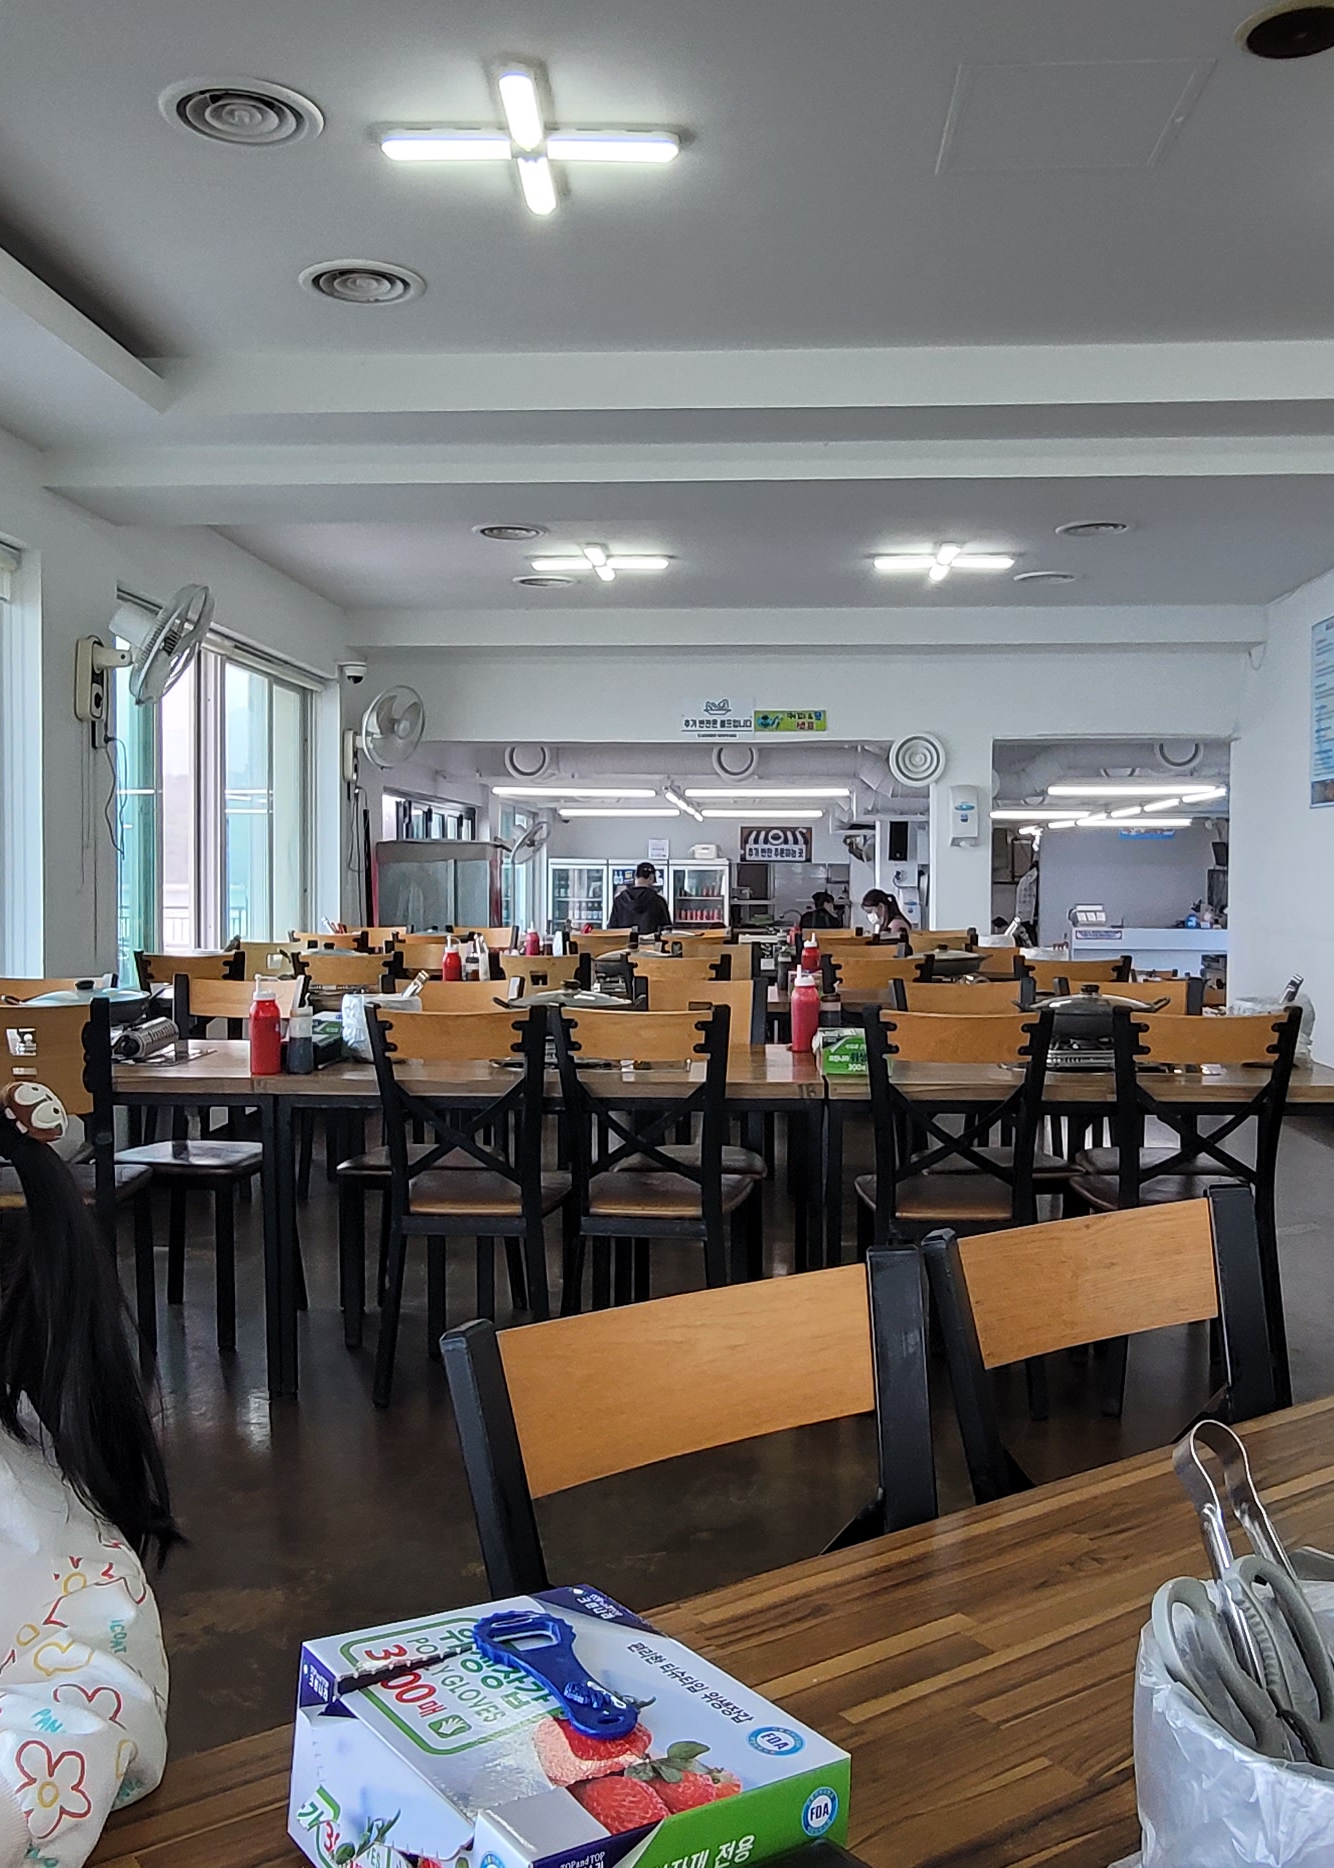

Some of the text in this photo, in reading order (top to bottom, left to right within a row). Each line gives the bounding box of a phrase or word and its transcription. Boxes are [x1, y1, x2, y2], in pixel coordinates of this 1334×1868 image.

[683, 719, 697, 728] 추가
[626, 1641, 755, 1724] 편리한 티슈타입 위생장갑
[760, 1732, 790, 1751] FDA
[809, 1802, 830, 1822] FDA
[714, 1834, 756, 1868] 전용
